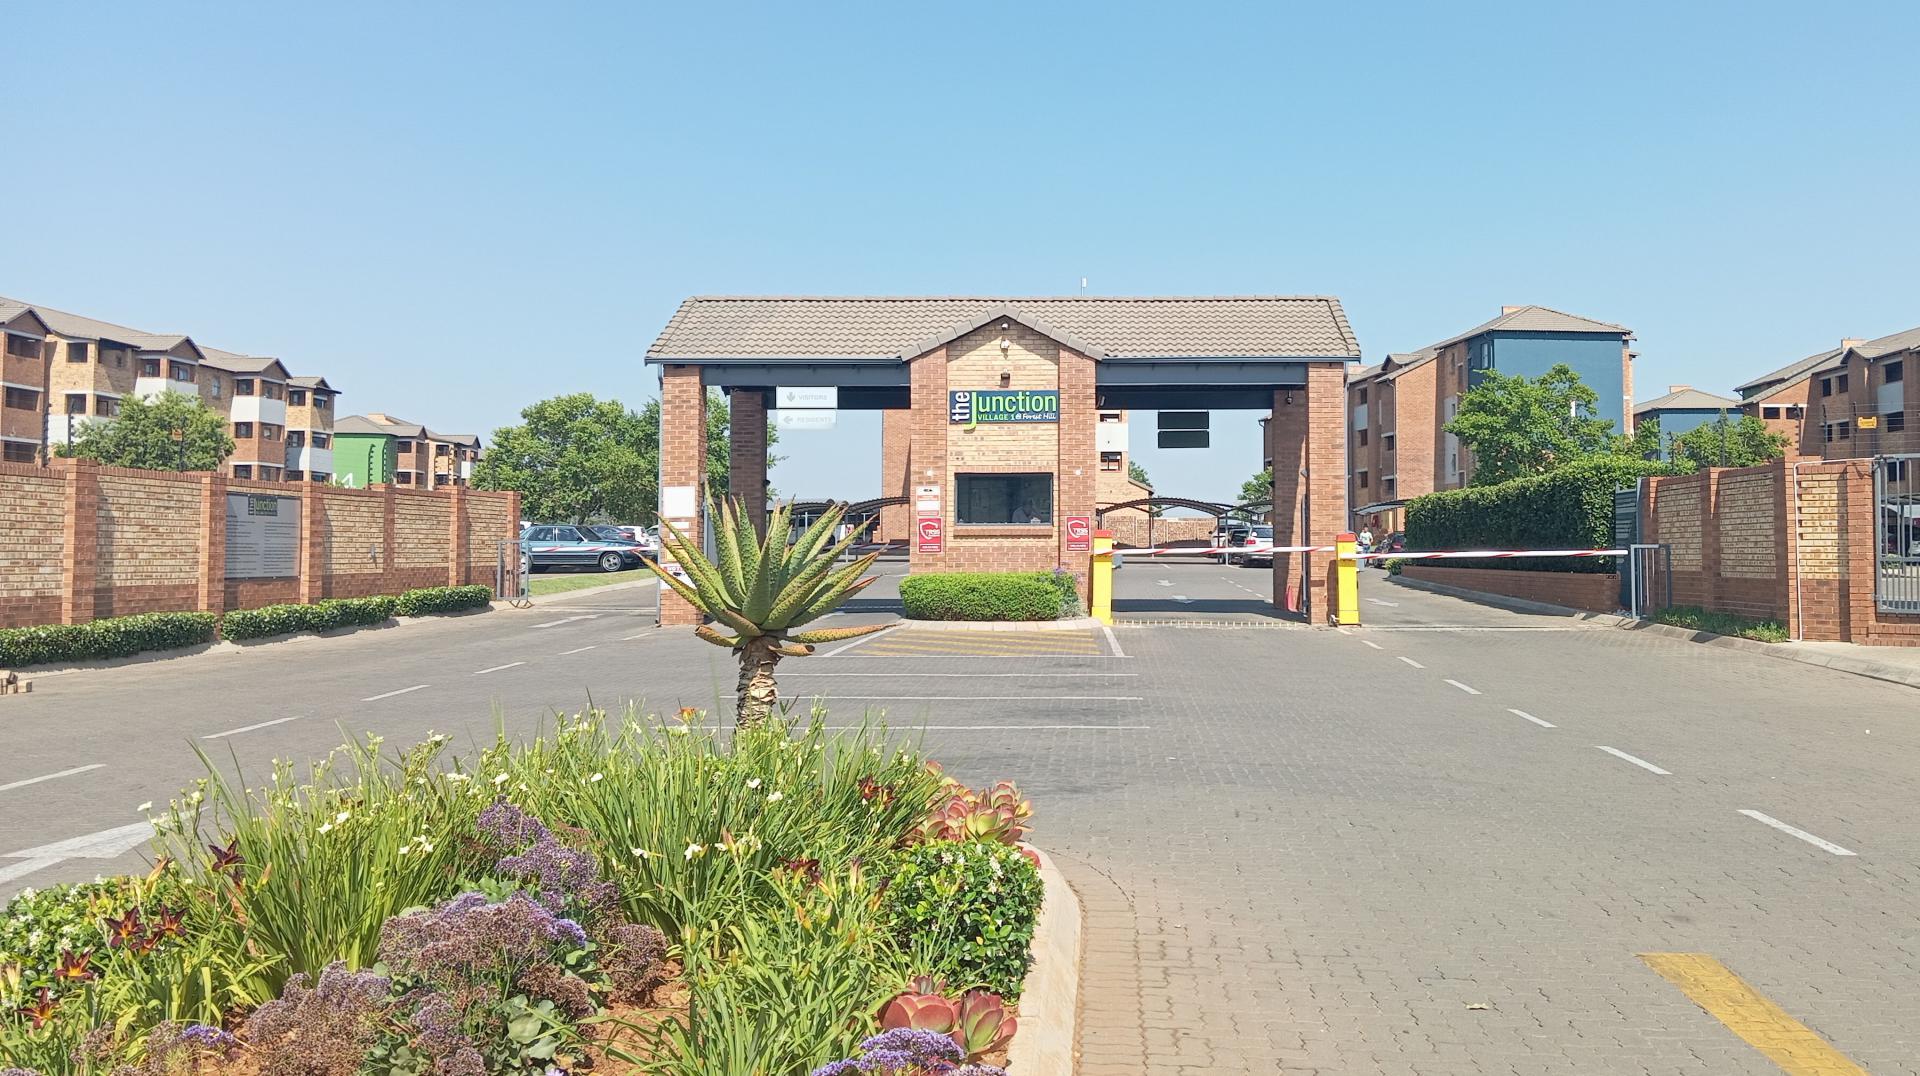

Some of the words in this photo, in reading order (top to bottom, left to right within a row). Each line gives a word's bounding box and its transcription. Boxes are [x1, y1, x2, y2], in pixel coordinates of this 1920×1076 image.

[952, 392, 970, 421] the
[963, 391, 1057, 429] Junction
[977, 413, 1008, 421] VILLAGE
